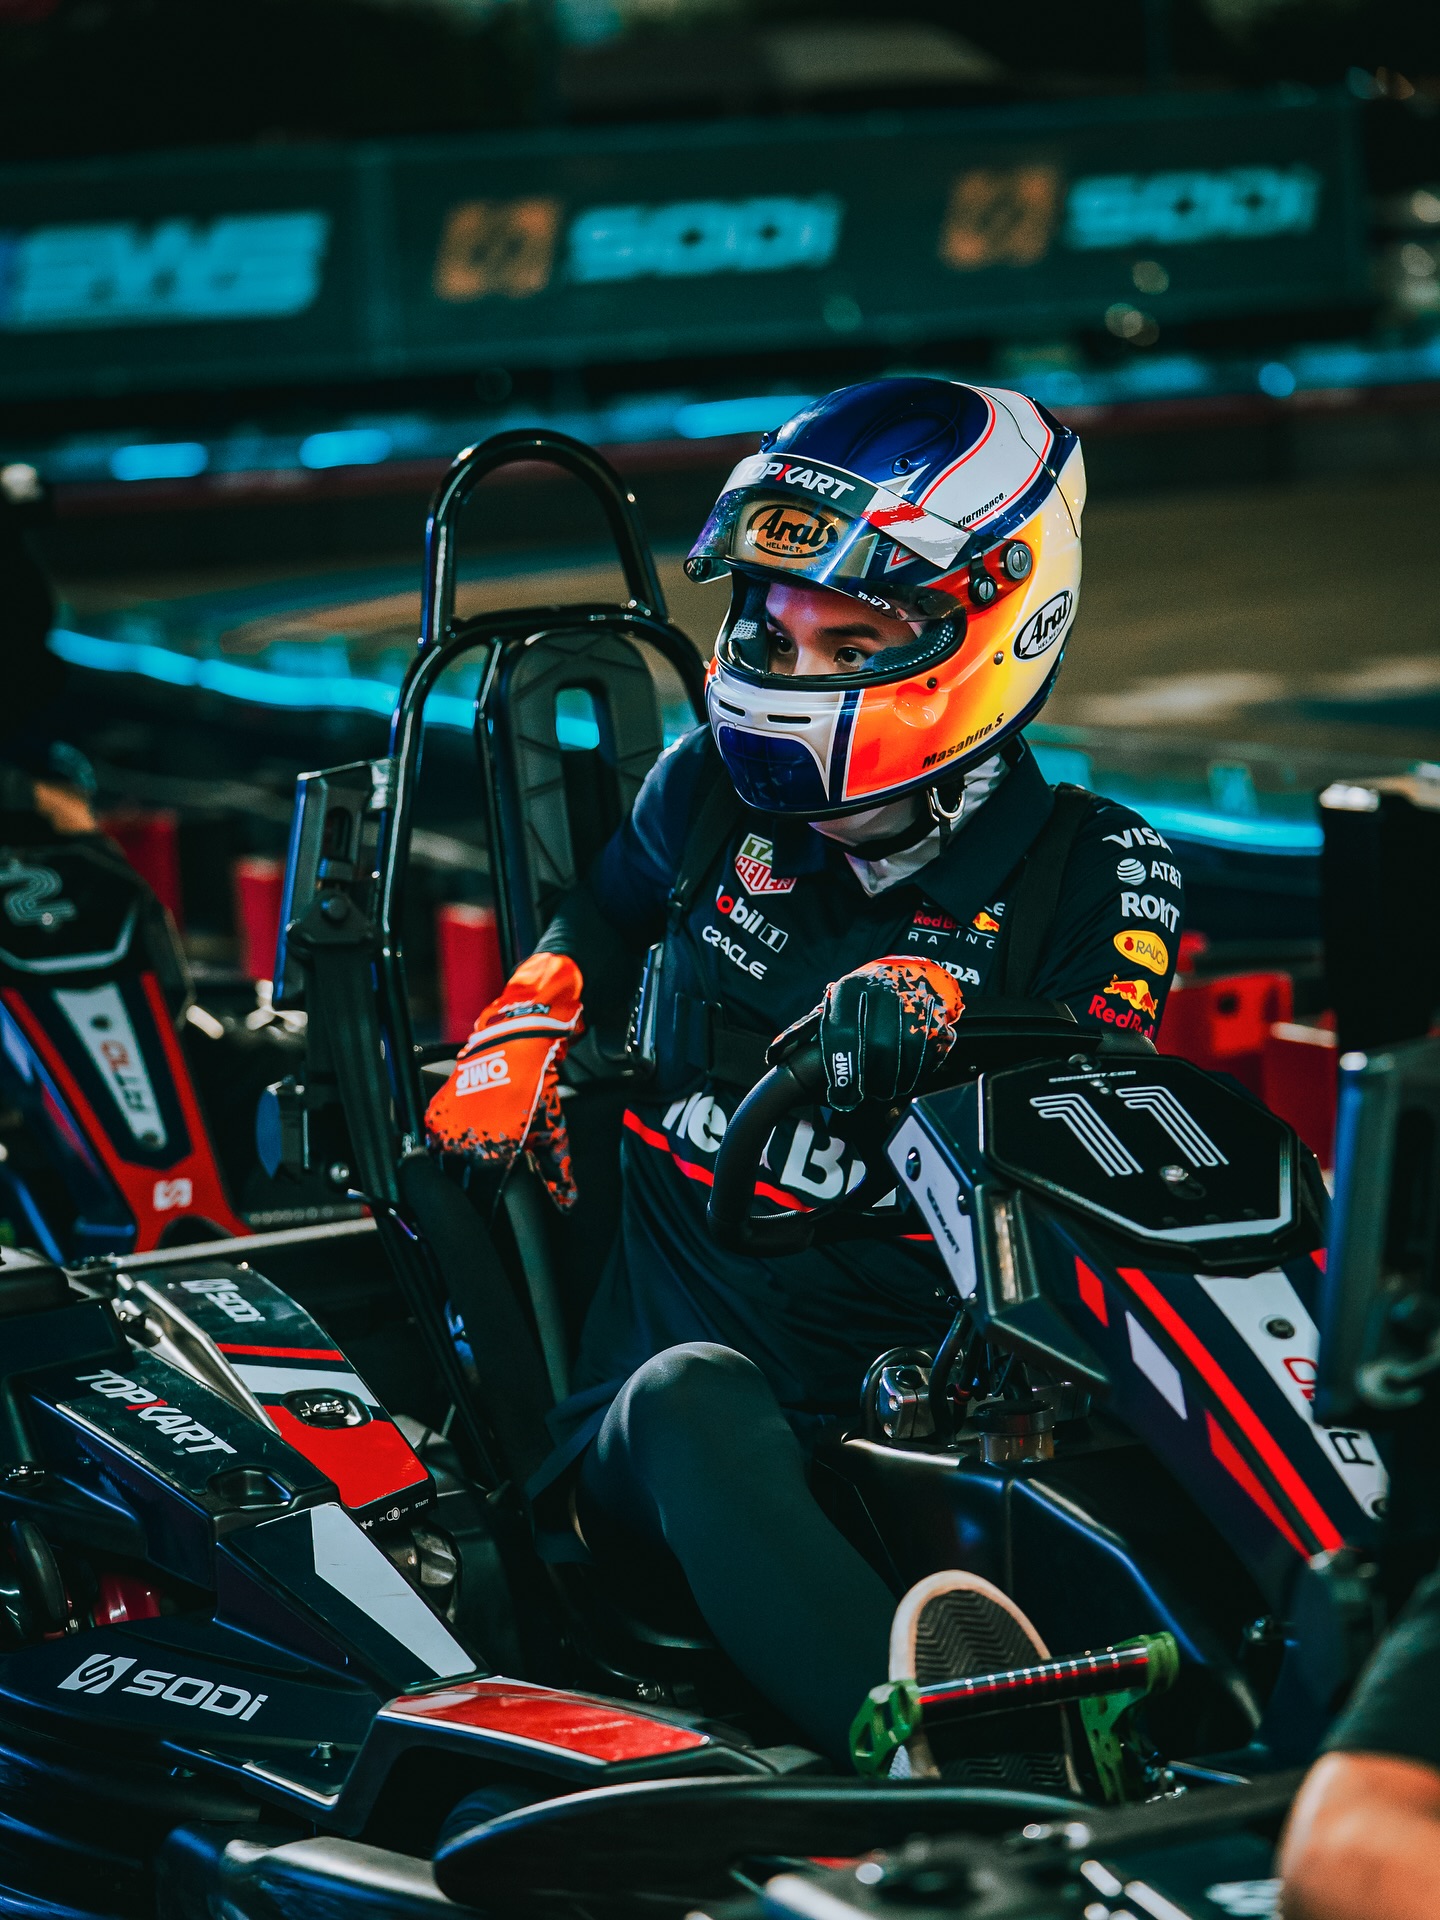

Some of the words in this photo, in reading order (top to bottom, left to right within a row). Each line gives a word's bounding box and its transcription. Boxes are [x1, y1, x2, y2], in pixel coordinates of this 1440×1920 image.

[759, 509, 830, 547] Arai
[1021, 594, 1067, 655] Arai
[751, 839, 773, 861] TA
[737, 857, 791, 891] HEUER
[716, 885, 764, 934] obil
[767, 929, 780, 946] 1
[1121, 892, 1180, 933] ROKT
[702, 926, 768, 980] ORACLE
[1136, 940, 1165, 965] RAUC
[1088, 994, 1133, 1028] Red
[456, 1056, 509, 1091] OMP
[835, 1052, 849, 1087] OMP
[75, 1369, 238, 1455] TOPKART
[414, 1498, 429, 1509] START
